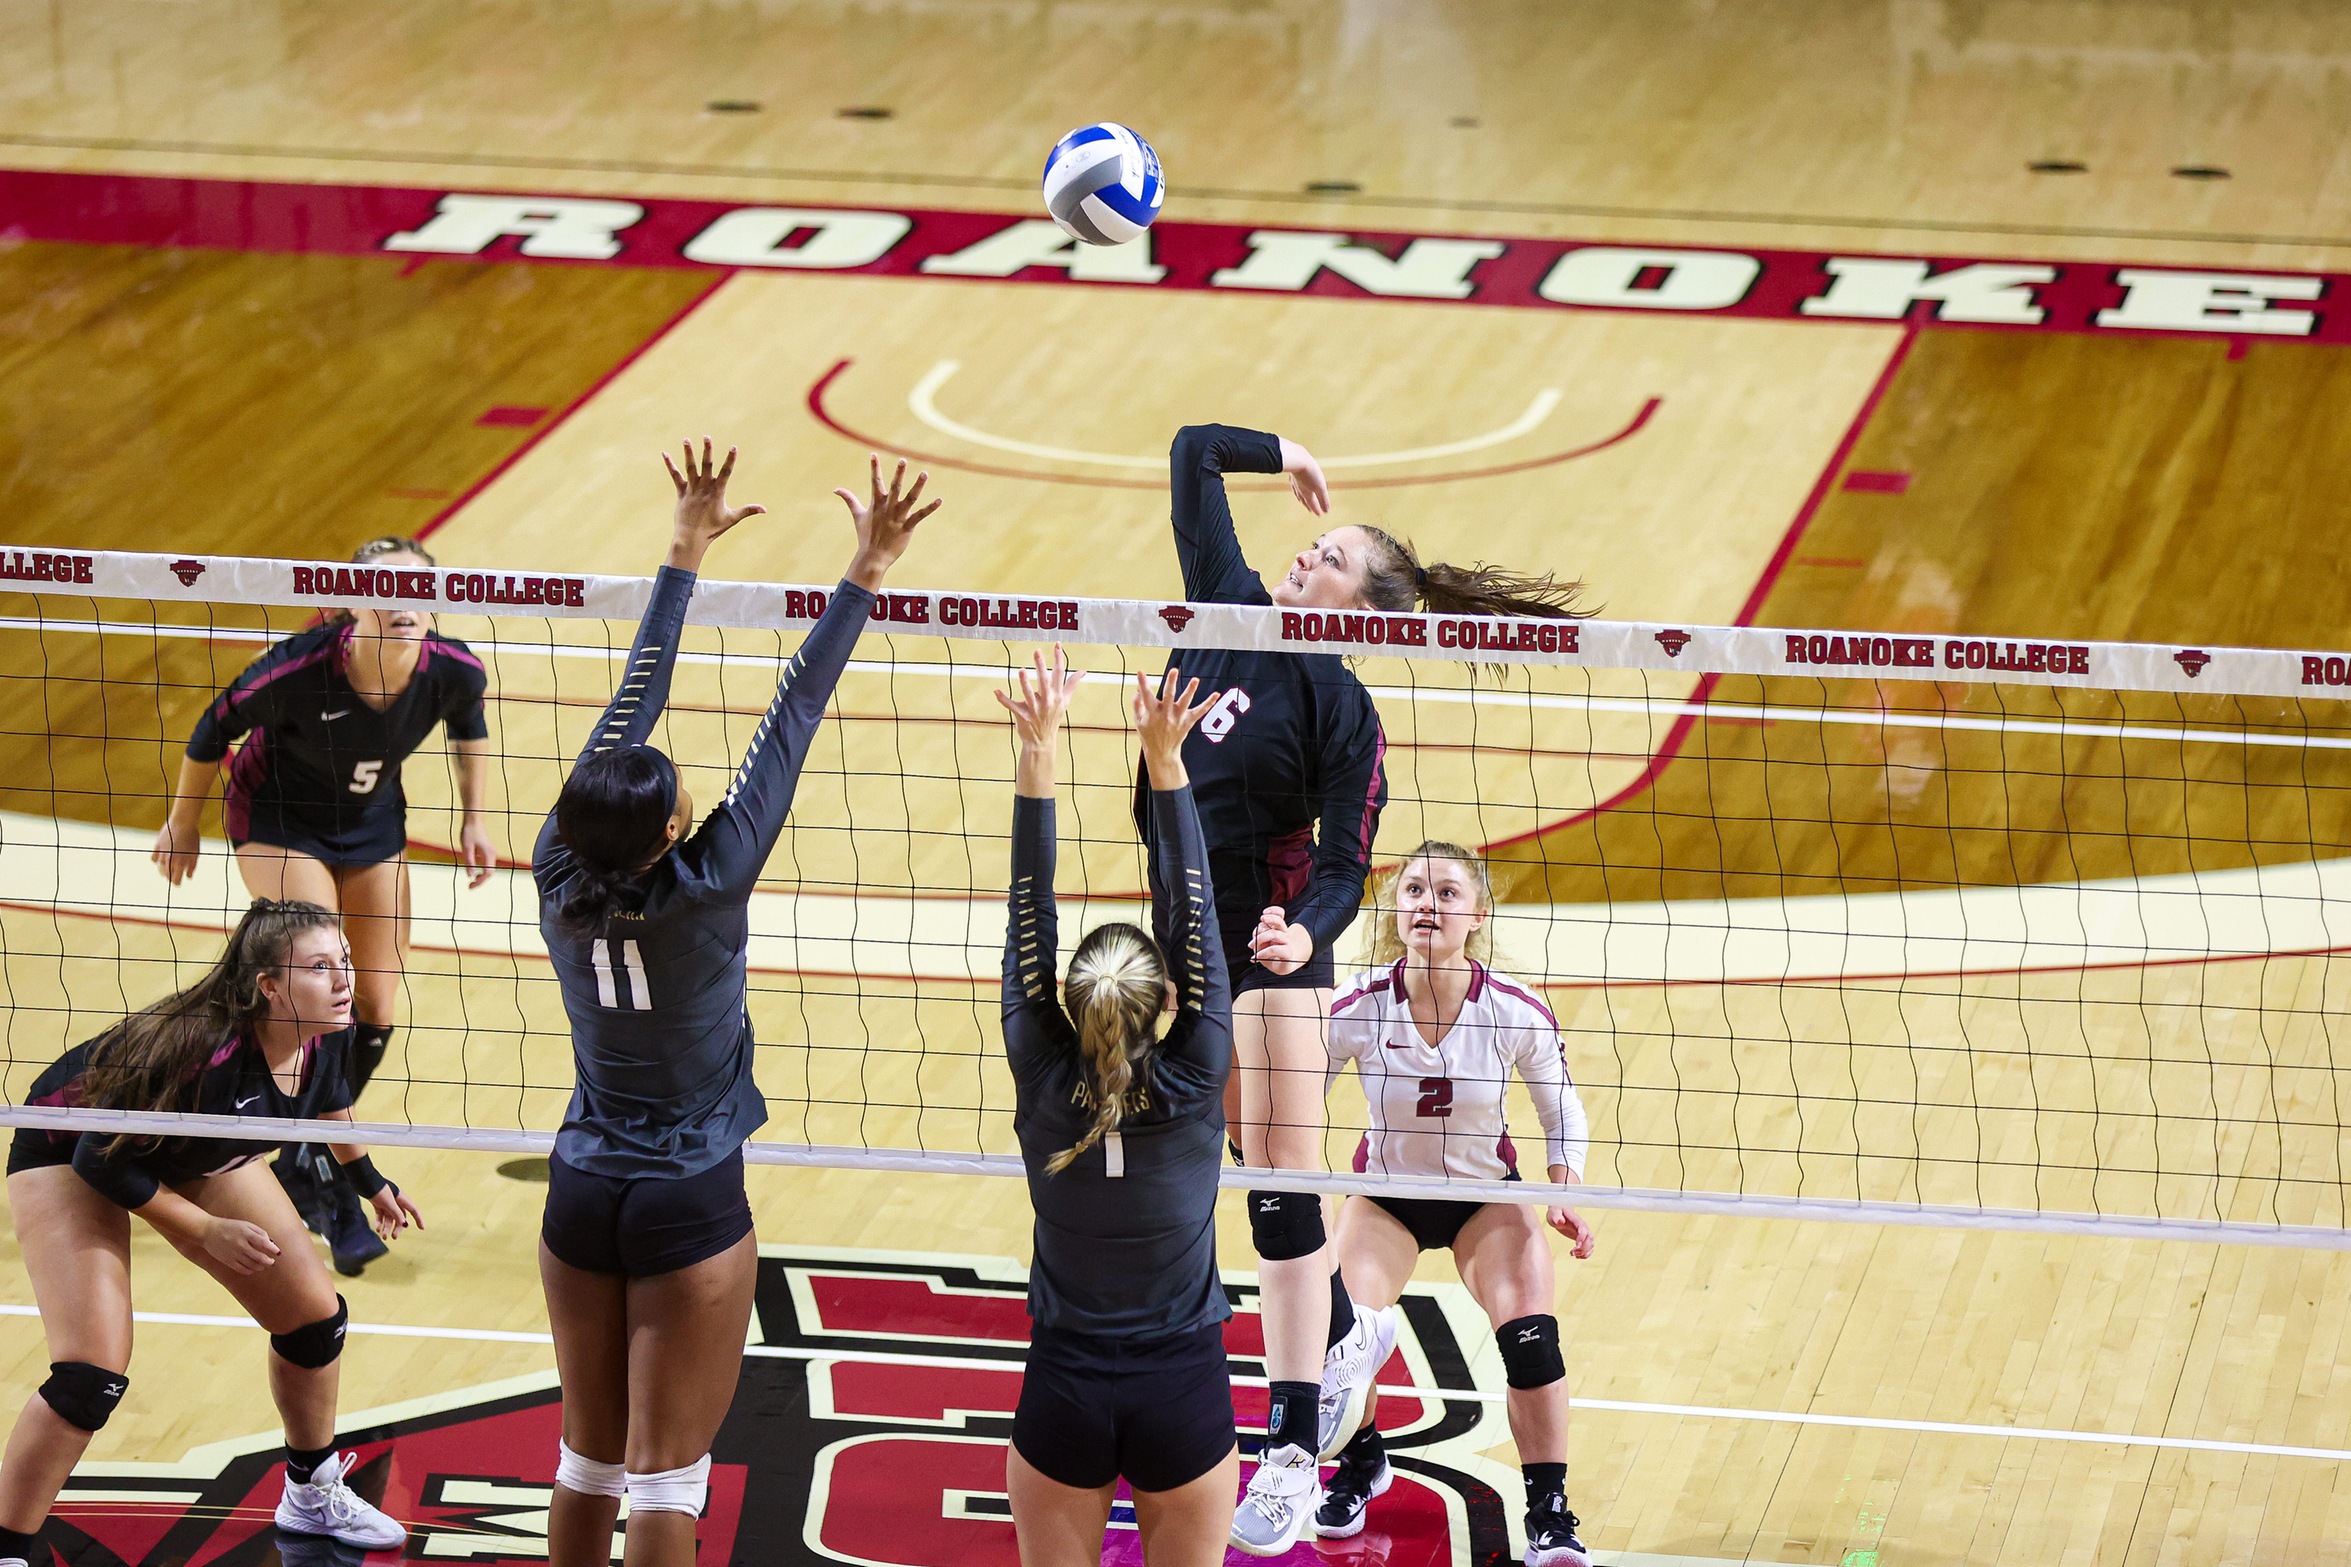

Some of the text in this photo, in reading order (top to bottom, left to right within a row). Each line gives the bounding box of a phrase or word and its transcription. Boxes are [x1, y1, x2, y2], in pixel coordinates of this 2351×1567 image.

[383, 192, 2326, 337] ROANOKE
[292, 566, 585, 607] ROANOKE COLLEGE
[785, 590, 1079, 631] ROOKE COLLEGE
[1281, 611, 1579, 654] ROANOKE COLLEGE
[1785, 634, 2089, 675] ROANOKE COLLEGE
[1200, 686, 1252, 744] 6
[348, 760, 384, 795] 5
[591, 938, 653, 1011] 11
[1416, 1077, 1454, 1117] 2
[1105, 1132, 1125, 1178] 1
